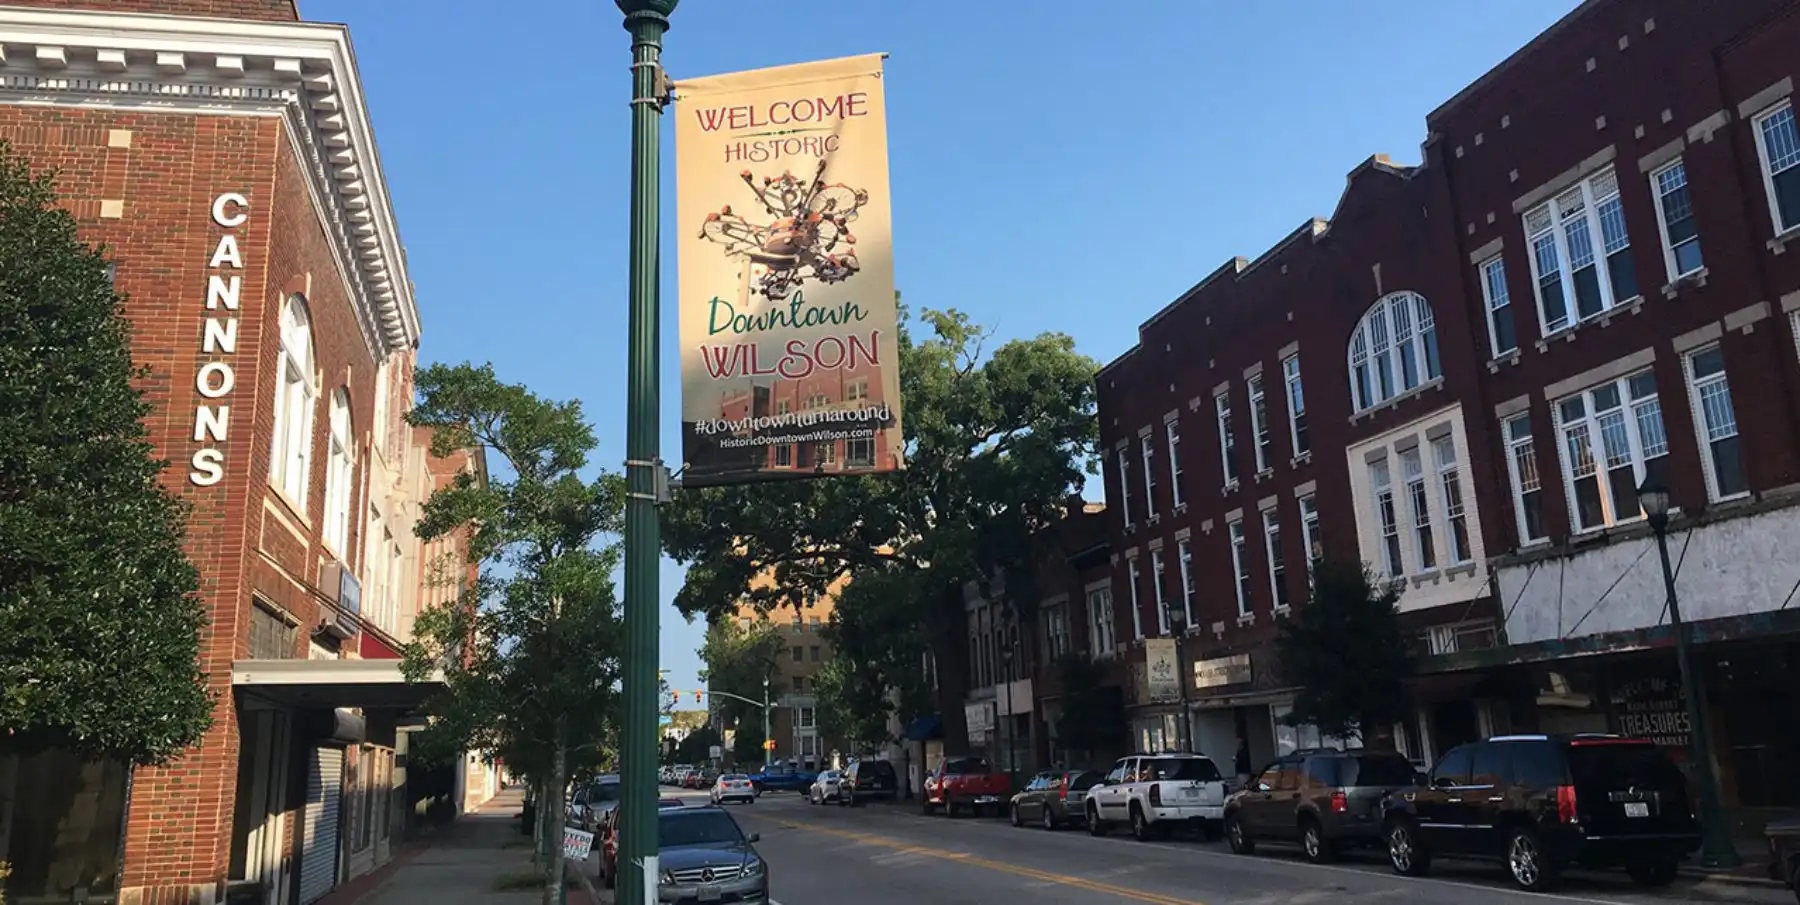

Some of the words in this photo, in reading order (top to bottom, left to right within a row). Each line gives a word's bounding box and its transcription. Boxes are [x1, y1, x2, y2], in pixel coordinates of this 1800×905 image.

[695, 92, 868, 132] WELCOME
[724, 134, 840, 164] HISTORIC
[708, 288, 869, 336] Downtown
[189, 192, 249, 486] CANNONS
[699, 330, 883, 381] WILSON
[694, 402, 891, 436] #downtownturnaround
[719, 428, 873, 449] HistoricDowntownWilson.com
[1618, 711, 1692, 737] TREASURES
